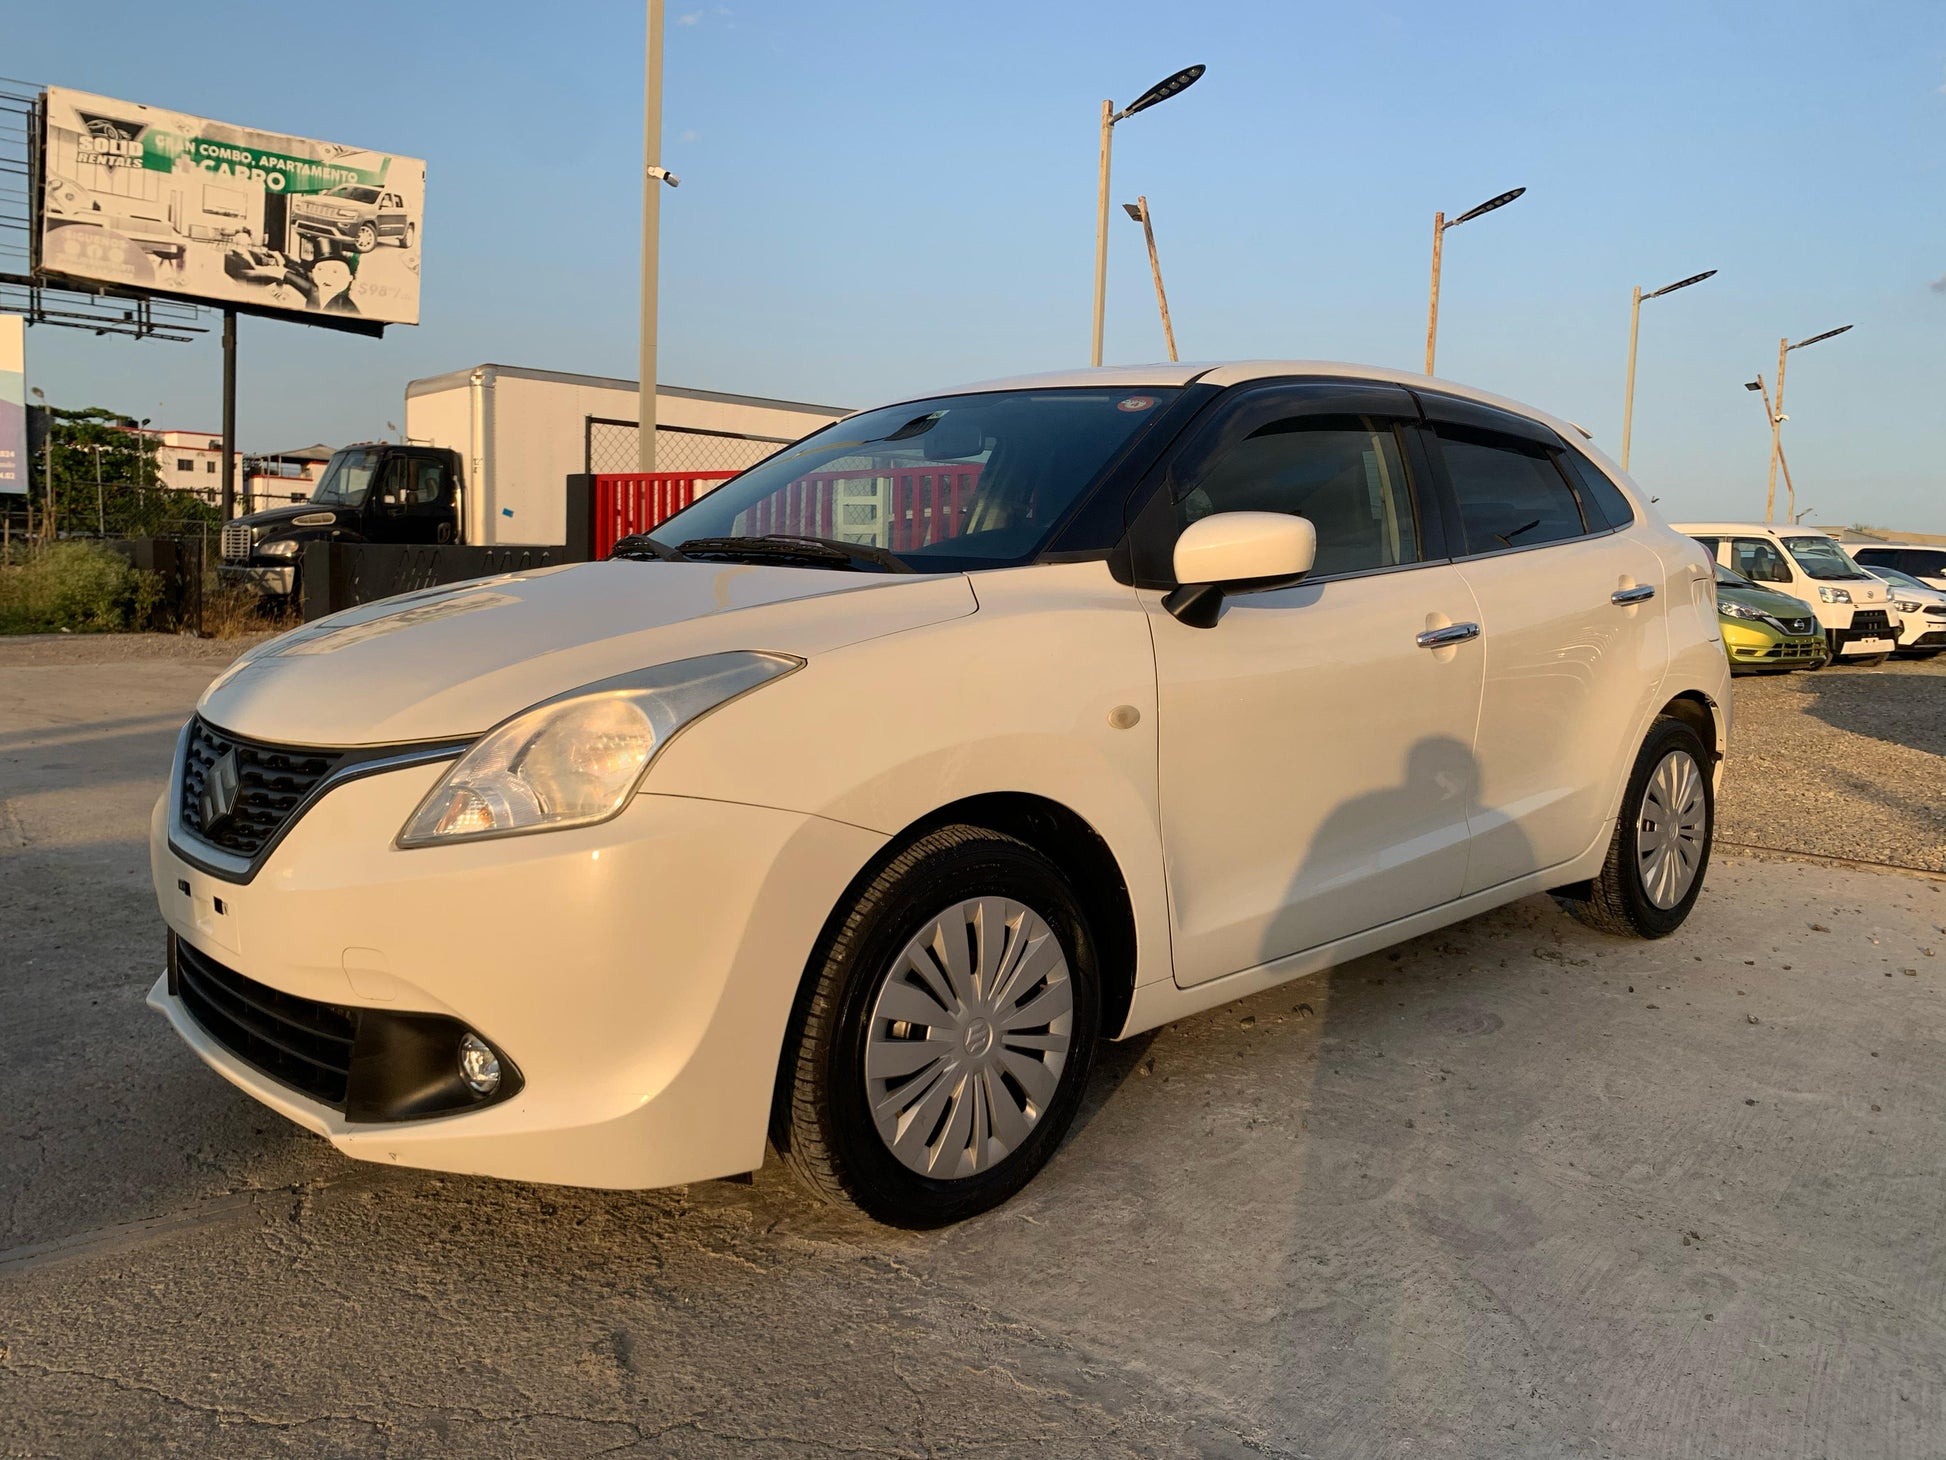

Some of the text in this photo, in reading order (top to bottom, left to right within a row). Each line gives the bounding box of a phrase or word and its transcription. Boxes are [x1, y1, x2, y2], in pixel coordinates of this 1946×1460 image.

[78, 135, 144, 157] SOLID
[77, 152, 144, 169] RENTALS
[199, 143, 256, 166] COMBO,
[259, 155, 359, 184] APARTAMENTO
